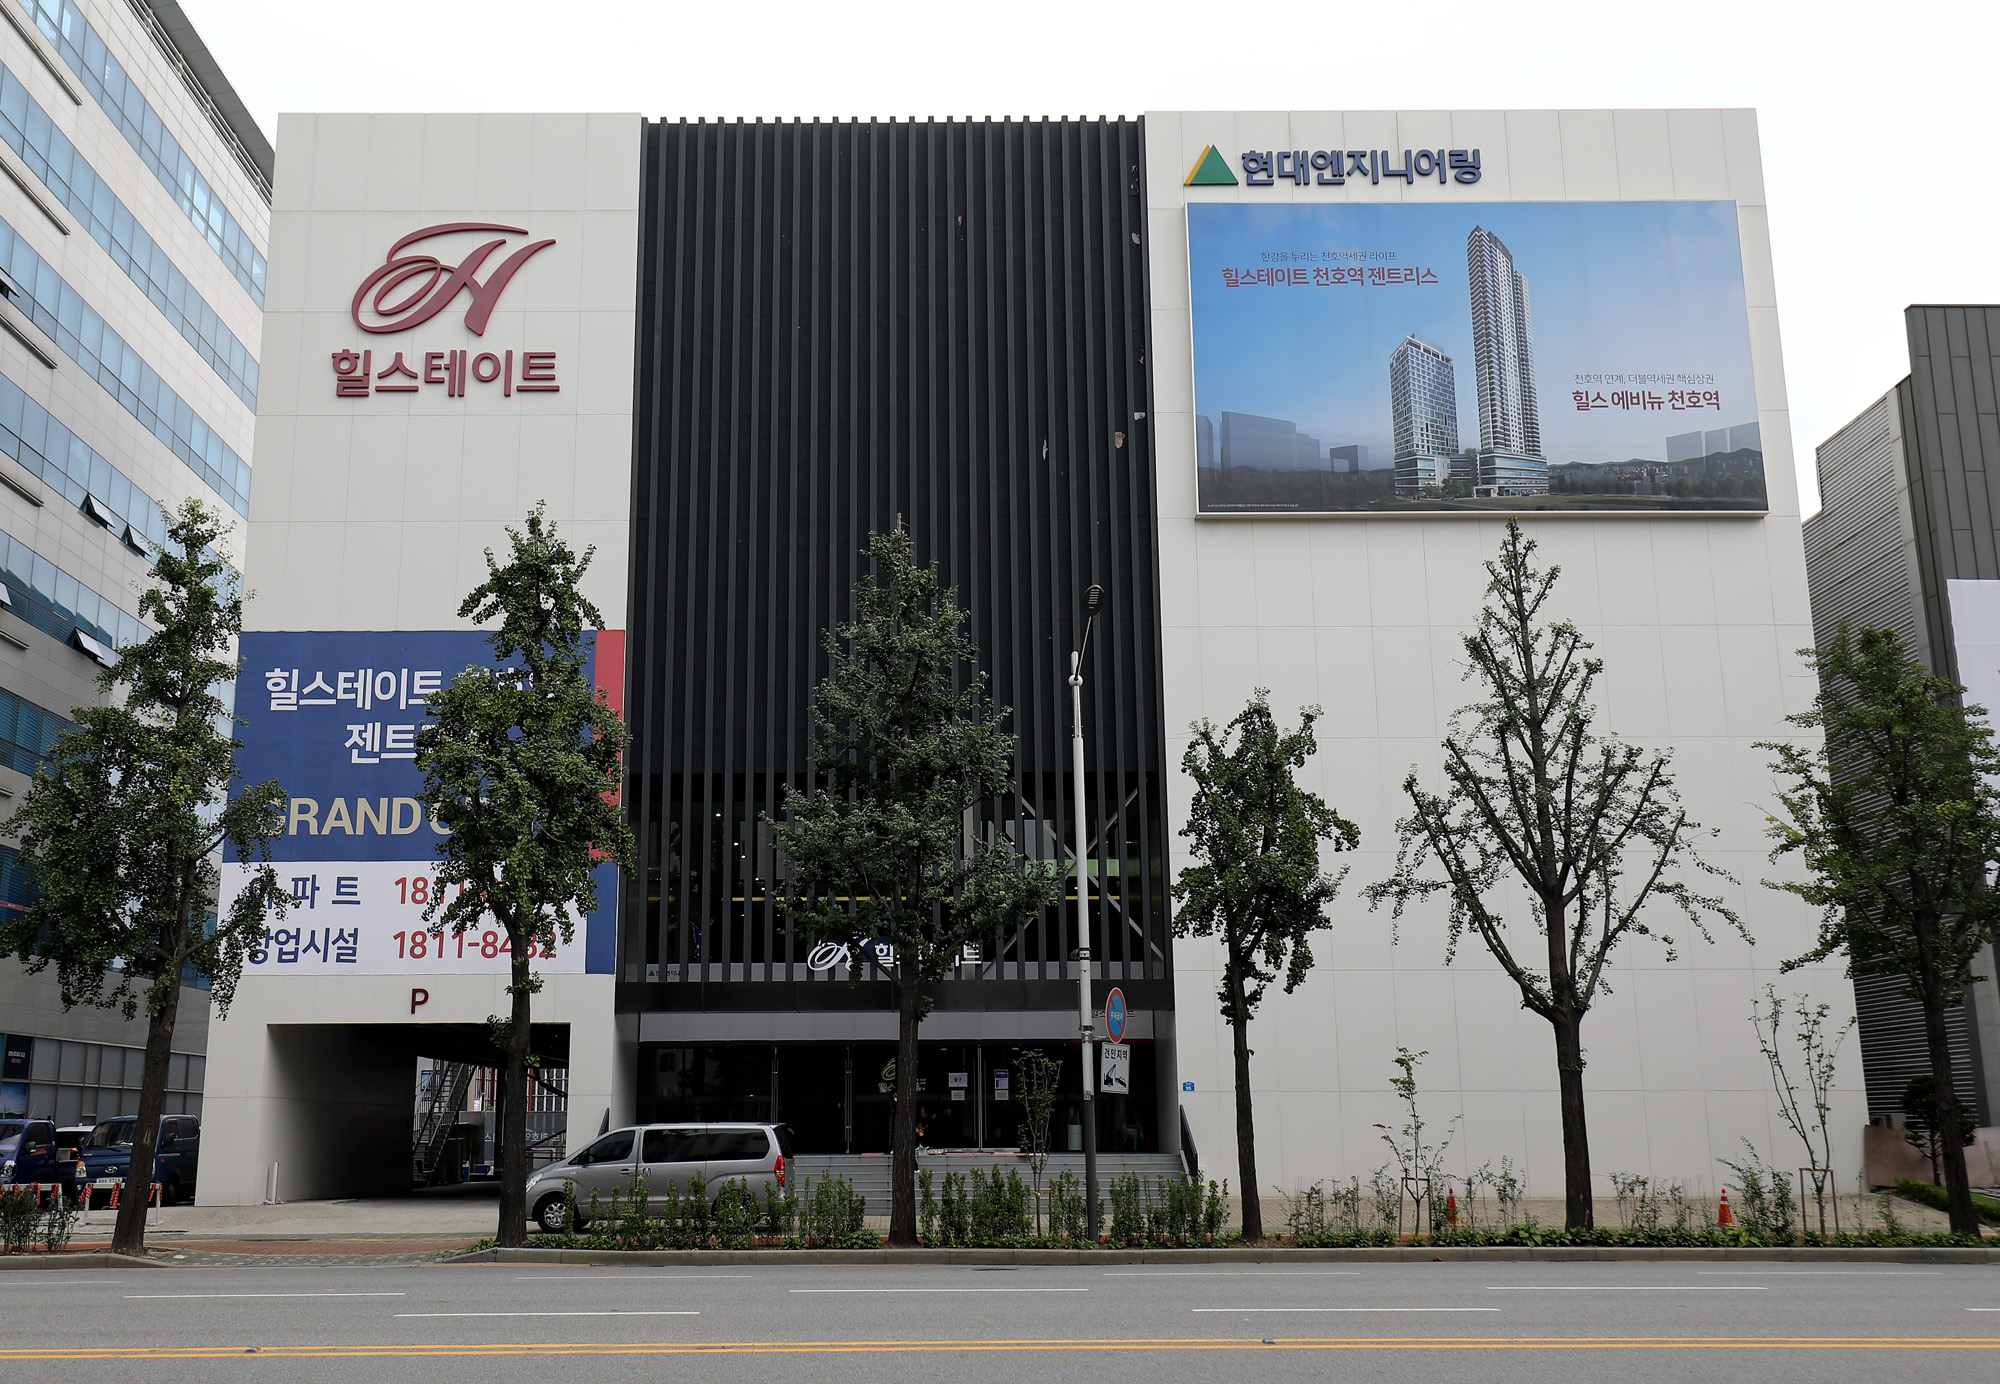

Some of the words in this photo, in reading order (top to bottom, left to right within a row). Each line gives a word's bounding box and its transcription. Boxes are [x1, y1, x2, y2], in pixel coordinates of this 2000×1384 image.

[1242, 149, 1482, 185] 현대엔지니어링
[1260, 251, 1289, 262] 한강을
[1290, 251, 1318, 262] 누리는
[1320, 251, 1367, 262] 천호역세권
[1368, 251, 1398, 262] 라이프
[1222, 267, 1310, 288] 힐스테이트
[1313, 267, 1365, 287] 천호역
[1368, 267, 1439, 287] 젠트리스
[331, 348, 561, 397] 힐스테이트
[1574, 373, 1603, 385] 천호역
[1604, 373, 1626, 386] 연계,
[1627, 373, 1675, 385] 더블역세권
[1676, 373, 1714, 385] 핵심상권
[1571, 390, 1609, 411] 힐스
[1611, 390, 1665, 411] 에비뉴
[1668, 390, 1721, 411] 천호역
[265, 667, 443, 711] 힐스테이트
[411, 988, 429, 1014] P
[1104, 1048, 1128, 1061] 견인지역
